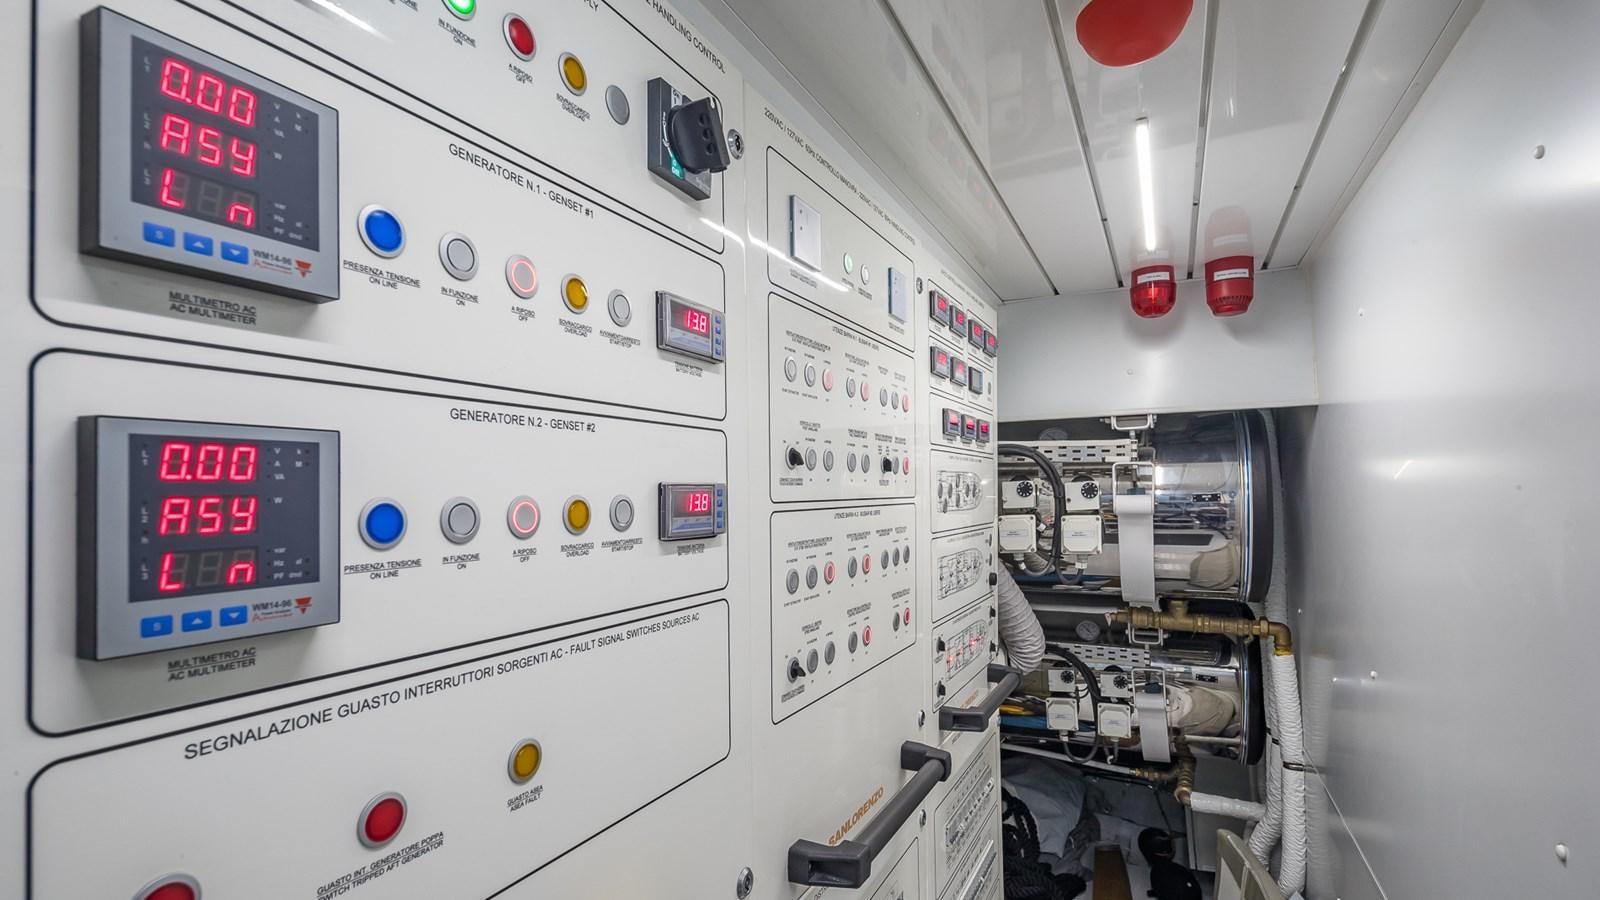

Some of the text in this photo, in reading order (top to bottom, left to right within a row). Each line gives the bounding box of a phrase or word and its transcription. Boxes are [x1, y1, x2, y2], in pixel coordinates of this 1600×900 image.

[438, 17, 476, 47] IN FUNZIONE
[453, 35, 463, 46] ON
[652, 0, 726, 74] HANDLING CONTROL
[161, 59, 256, 127] 0.00
[448, 143, 525, 187] GENERATORE
[526, 180, 543, 195] N.1
[548, 189, 583, 215] GENSET
[584, 208, 595, 220] #1
[343, 259, 421, 288] PRESENZA TENSIONE
[369, 275, 398, 289] ON LINE
[169, 289, 257, 317] MULTIMETRO AC
[440, 286, 479, 303] IN FUNZIONE
[455, 297, 466, 307] ON
[170, 302, 257, 326] AC MULTIMETER
[518, 314, 529, 322] OFF
[449, 407, 525, 426] GENERATORE
[527, 416, 543, 428] N.2
[550, 418, 585, 432] GENSET
[586, 424, 596, 433] #2
[161, 443, 256, 480] 0.00
[441, 552, 481, 563] IN FUNZIONE
[517, 547, 537, 556] RIPOSO
[560, 542, 595, 553] SOVRACCARICO
[565, 549, 591, 558] OVERLOAD
[343, 558, 422, 574] PRESENZA TENSIONE
[456, 562, 467, 570] ON
[519, 555, 531, 563] OFF
[369, 569, 400, 580] ON LINE
[252, 599, 292, 612] WM14-96
[168, 647, 257, 672] MULTIMETRO AC
[169, 657, 257, 683] AC MULTIMETER
[184, 707, 333, 760] SEGNALAZIONE
[336, 690, 402, 720] GUASTO
[404, 665, 495, 700] INTERRUTTORI
[496, 651, 549, 675] SORGENTI
[550, 646, 564, 661] AC
[570, 638, 597, 656] FAULT
[598, 632, 625, 648] SIGNAL
[626, 622, 662, 641] SWITCHES
[662, 615, 690, 631] SOURCES
[691, 612, 700, 623] AC
[507, 790, 530, 807] GUASTO
[828, 786, 884, 846] SANLORENZO
[316, 873, 352, 896] GUASTO
[370, 841, 420, 871] GENERATORE
[421, 831, 444, 846] POPPA
[352, 867, 385, 889] TRIPPED
[386, 860, 400, 872] AFT
[400, 839, 444, 865] GENERATOR
